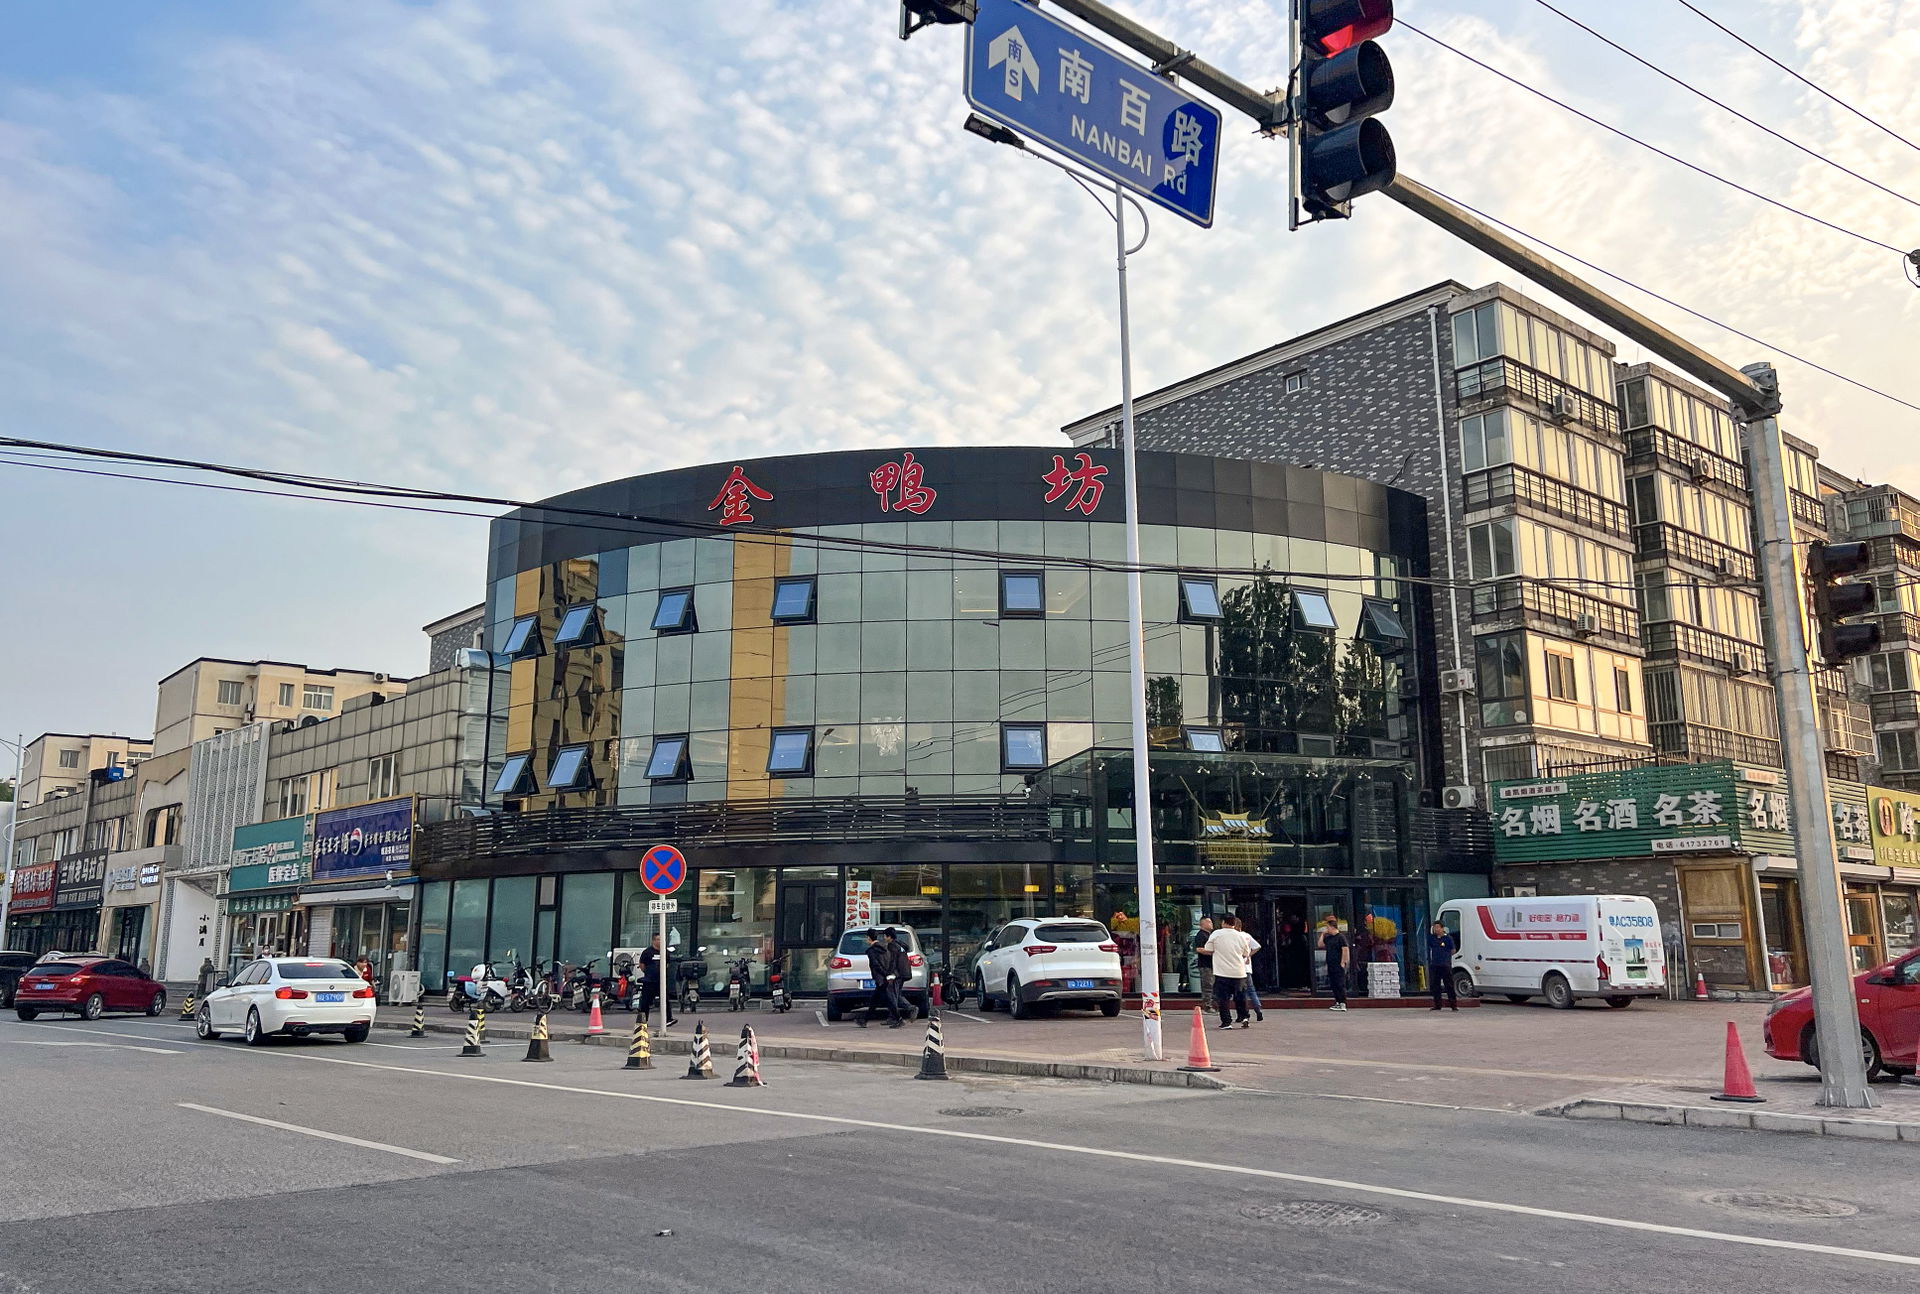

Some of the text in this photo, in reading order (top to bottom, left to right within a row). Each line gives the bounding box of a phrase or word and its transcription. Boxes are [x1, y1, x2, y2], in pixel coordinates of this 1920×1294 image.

[1007, 38, 1022, 61] 南
[1009, 68, 1020, 88] S
[1058, 48, 1204, 167] 南百路
[1071, 114, 1187, 196] NANBAI Rd
[708, 452, 1109, 526] 金鸭坊
[1500, 790, 1723, 837] 名烟 名酒 名茶
